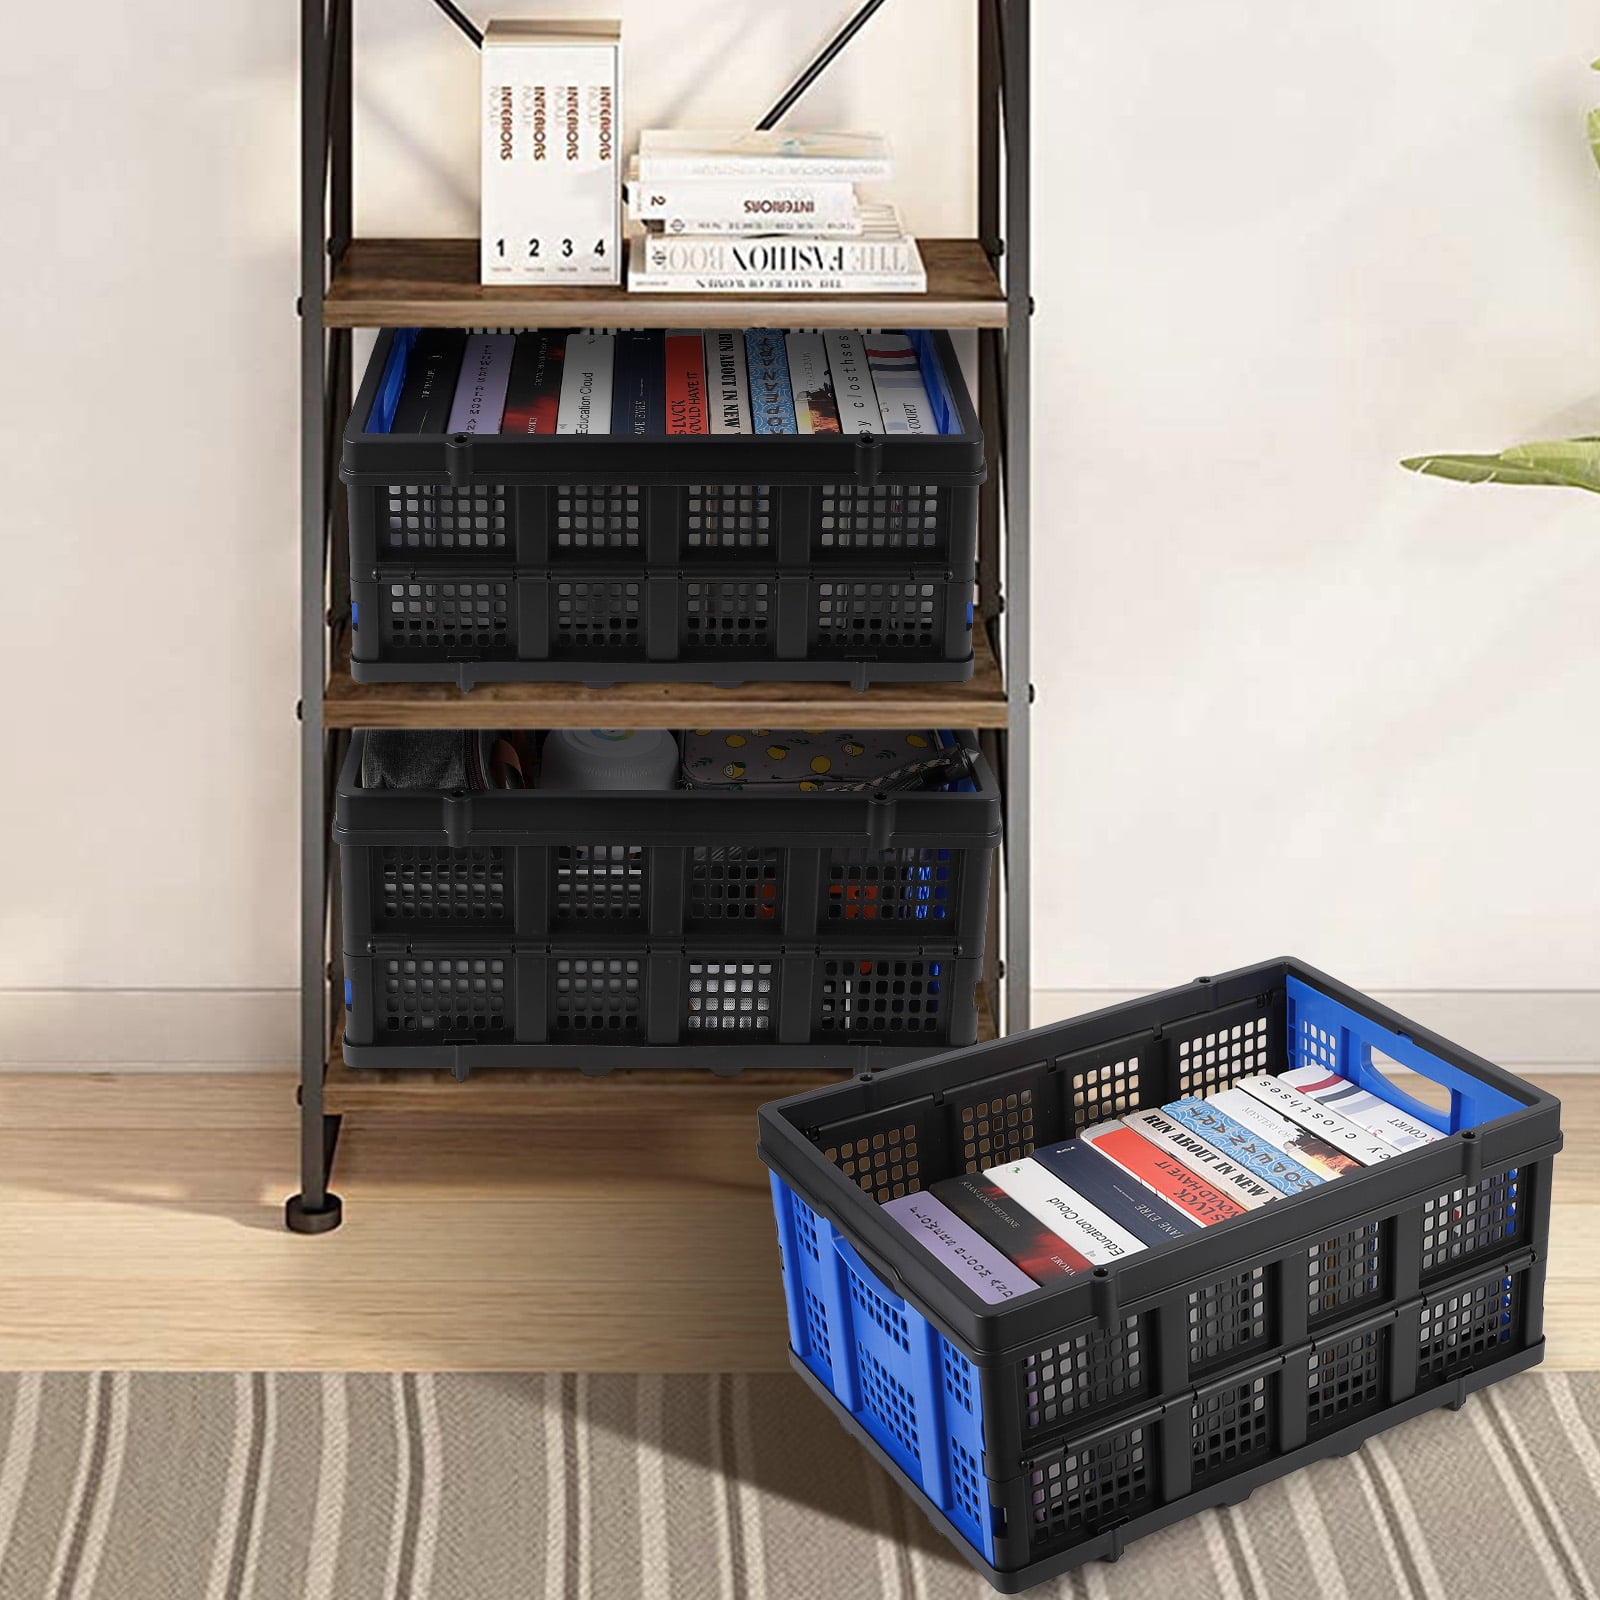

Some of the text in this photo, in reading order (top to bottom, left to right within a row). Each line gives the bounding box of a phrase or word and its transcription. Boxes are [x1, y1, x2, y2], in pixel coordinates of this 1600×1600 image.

[500, 85, 512, 161] INTERIORS
[533, 85, 545, 161] INTERIORS
[566, 85, 578, 161] INTERIORS
[599, 85, 611, 161] INTERIORS
[650, 195, 667, 207] 2
[743, 199, 815, 214] INTERIORS
[496, 238, 505, 257] 1
[528, 238, 540, 257] 2
[561, 238, 574, 257] 3
[593, 238, 606, 257] 4
[732, 245, 844, 272] FASHION
[851, 245, 909, 271] THE
[759, 338, 776, 367] ART
[686, 371, 698, 379] IT
[718, 333, 741, 428] RUN ABOUT IN NEW
[575, 372, 594, 435] Education Cloud
[687, 380, 700, 405] HAVE
[671, 400, 687, 428] LUCK
[902, 402, 921, 430] COURT
[1188, 1107, 1226, 1134] ART
[1258, 1079, 1358, 1141] closthses
[1386, 1118, 1428, 1139] COURT
[1142, 1114, 1270, 1197] RUN ABOUT IN NEW
[1155, 1160, 1172, 1170] IT
[1166, 1167, 1202, 1191] HAVE
[1133, 1202, 1163, 1223] EYRE
[1172, 1188, 1216, 1217] LUCK
[1046, 1197, 1126, 1258] Education Cloud
[909, 1206, 1014, 1299] FLOWERS BLOOM AND
